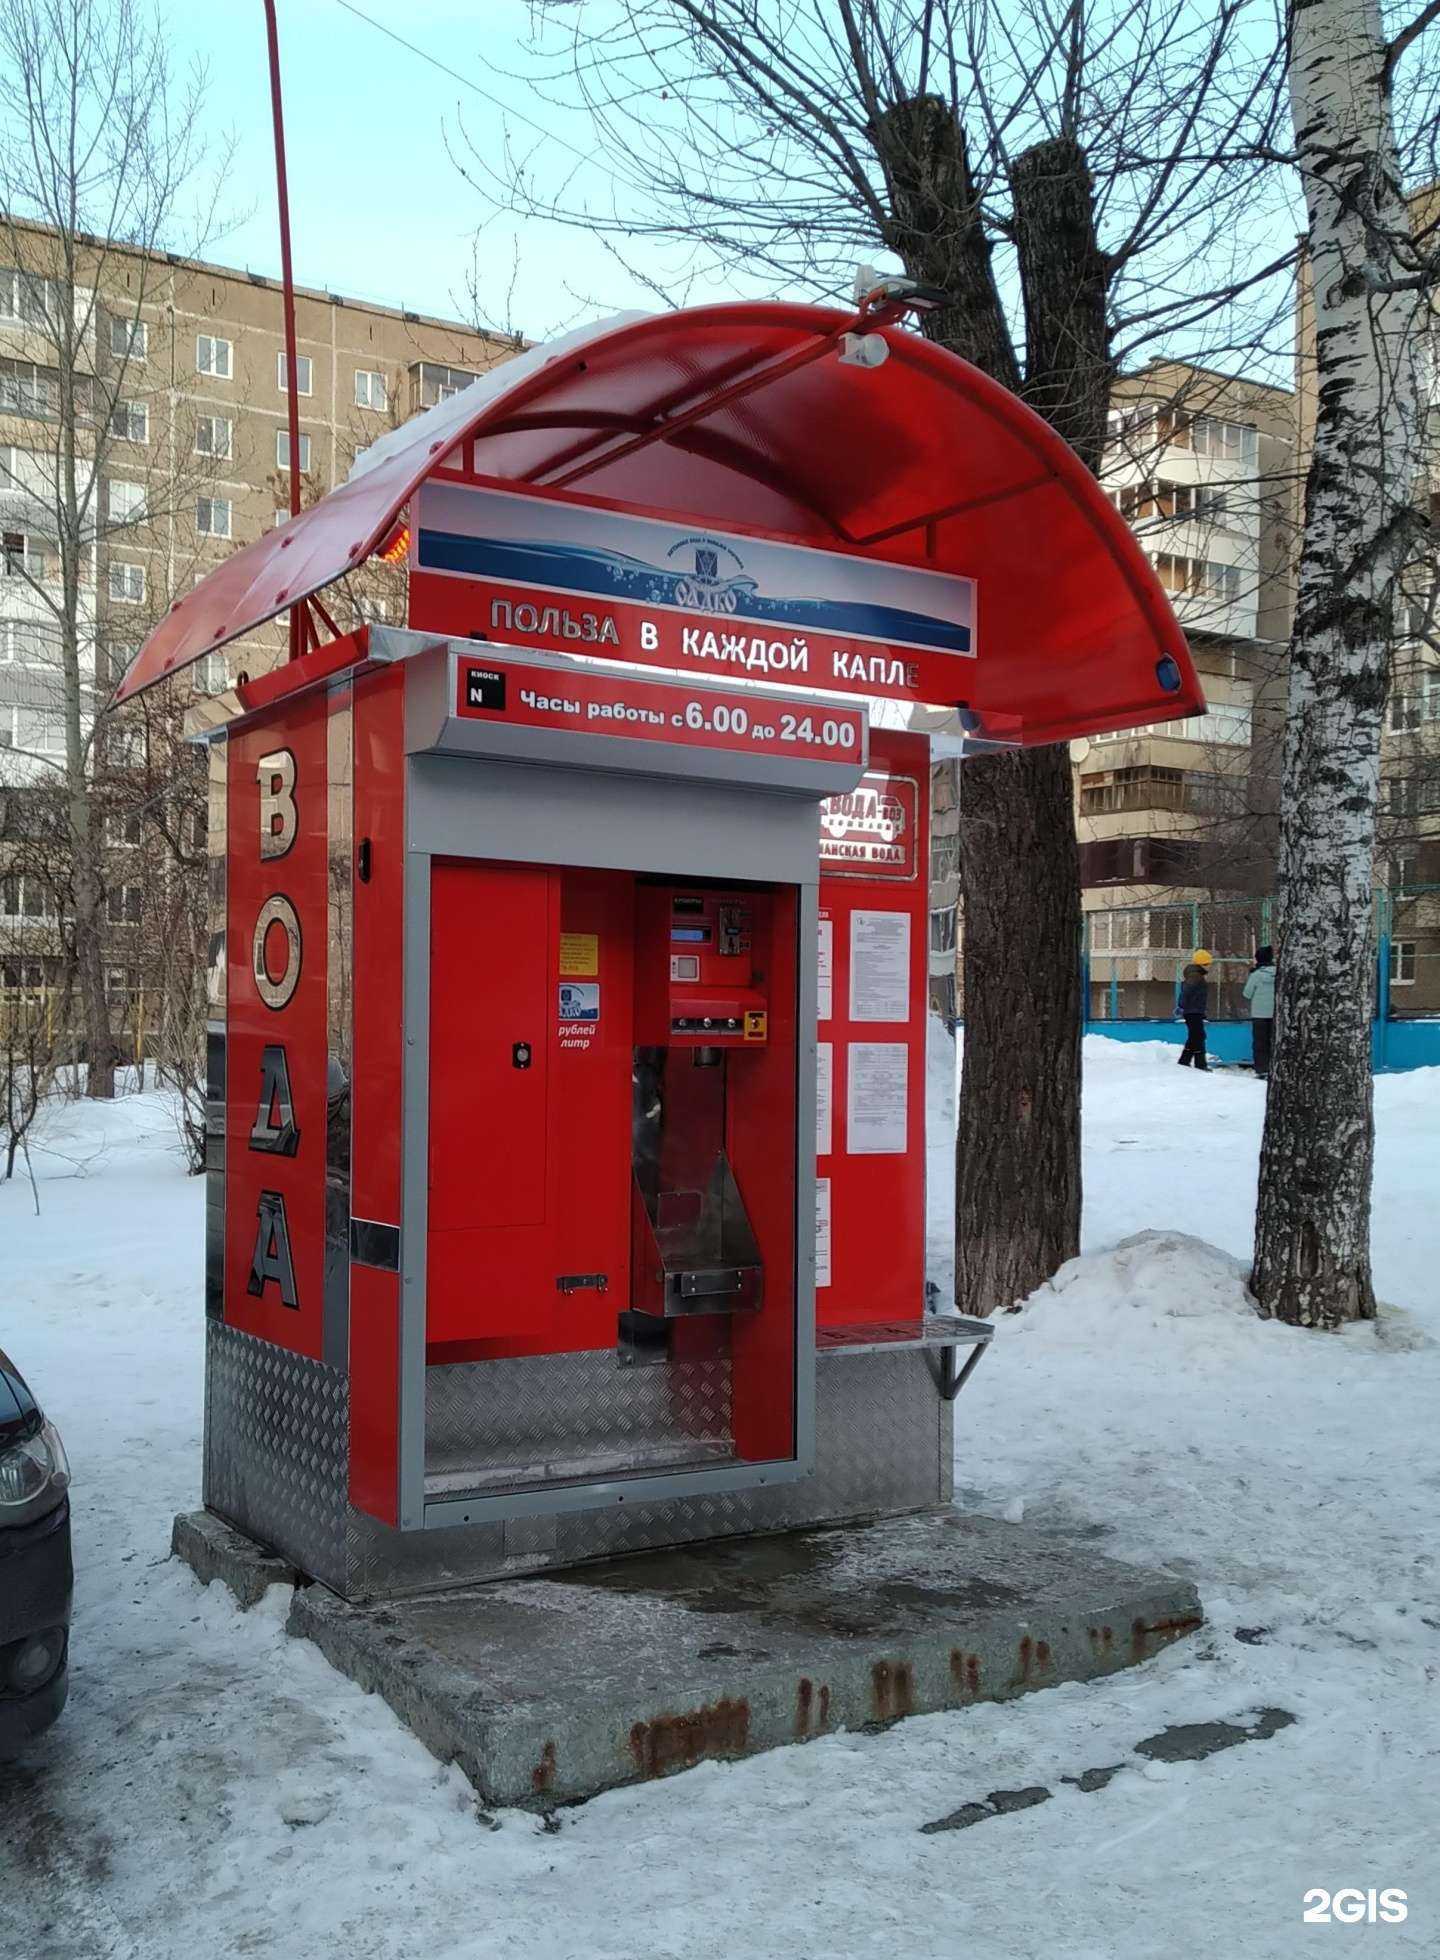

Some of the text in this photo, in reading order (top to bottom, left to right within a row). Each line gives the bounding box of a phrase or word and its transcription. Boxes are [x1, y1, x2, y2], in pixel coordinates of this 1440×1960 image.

[490, 598, 920, 688] ПОЛЬЗА В КАЖДОЙ КАПЛЕ
[470, 688, 483, 703] N
[520, 689, 856, 749] Часы работы с 6.00 до 24.00
[247, 747, 302, 1311] ВОДА
[558, 1024, 597, 1037] рублей
[560, 1038, 590, 1050] литр
